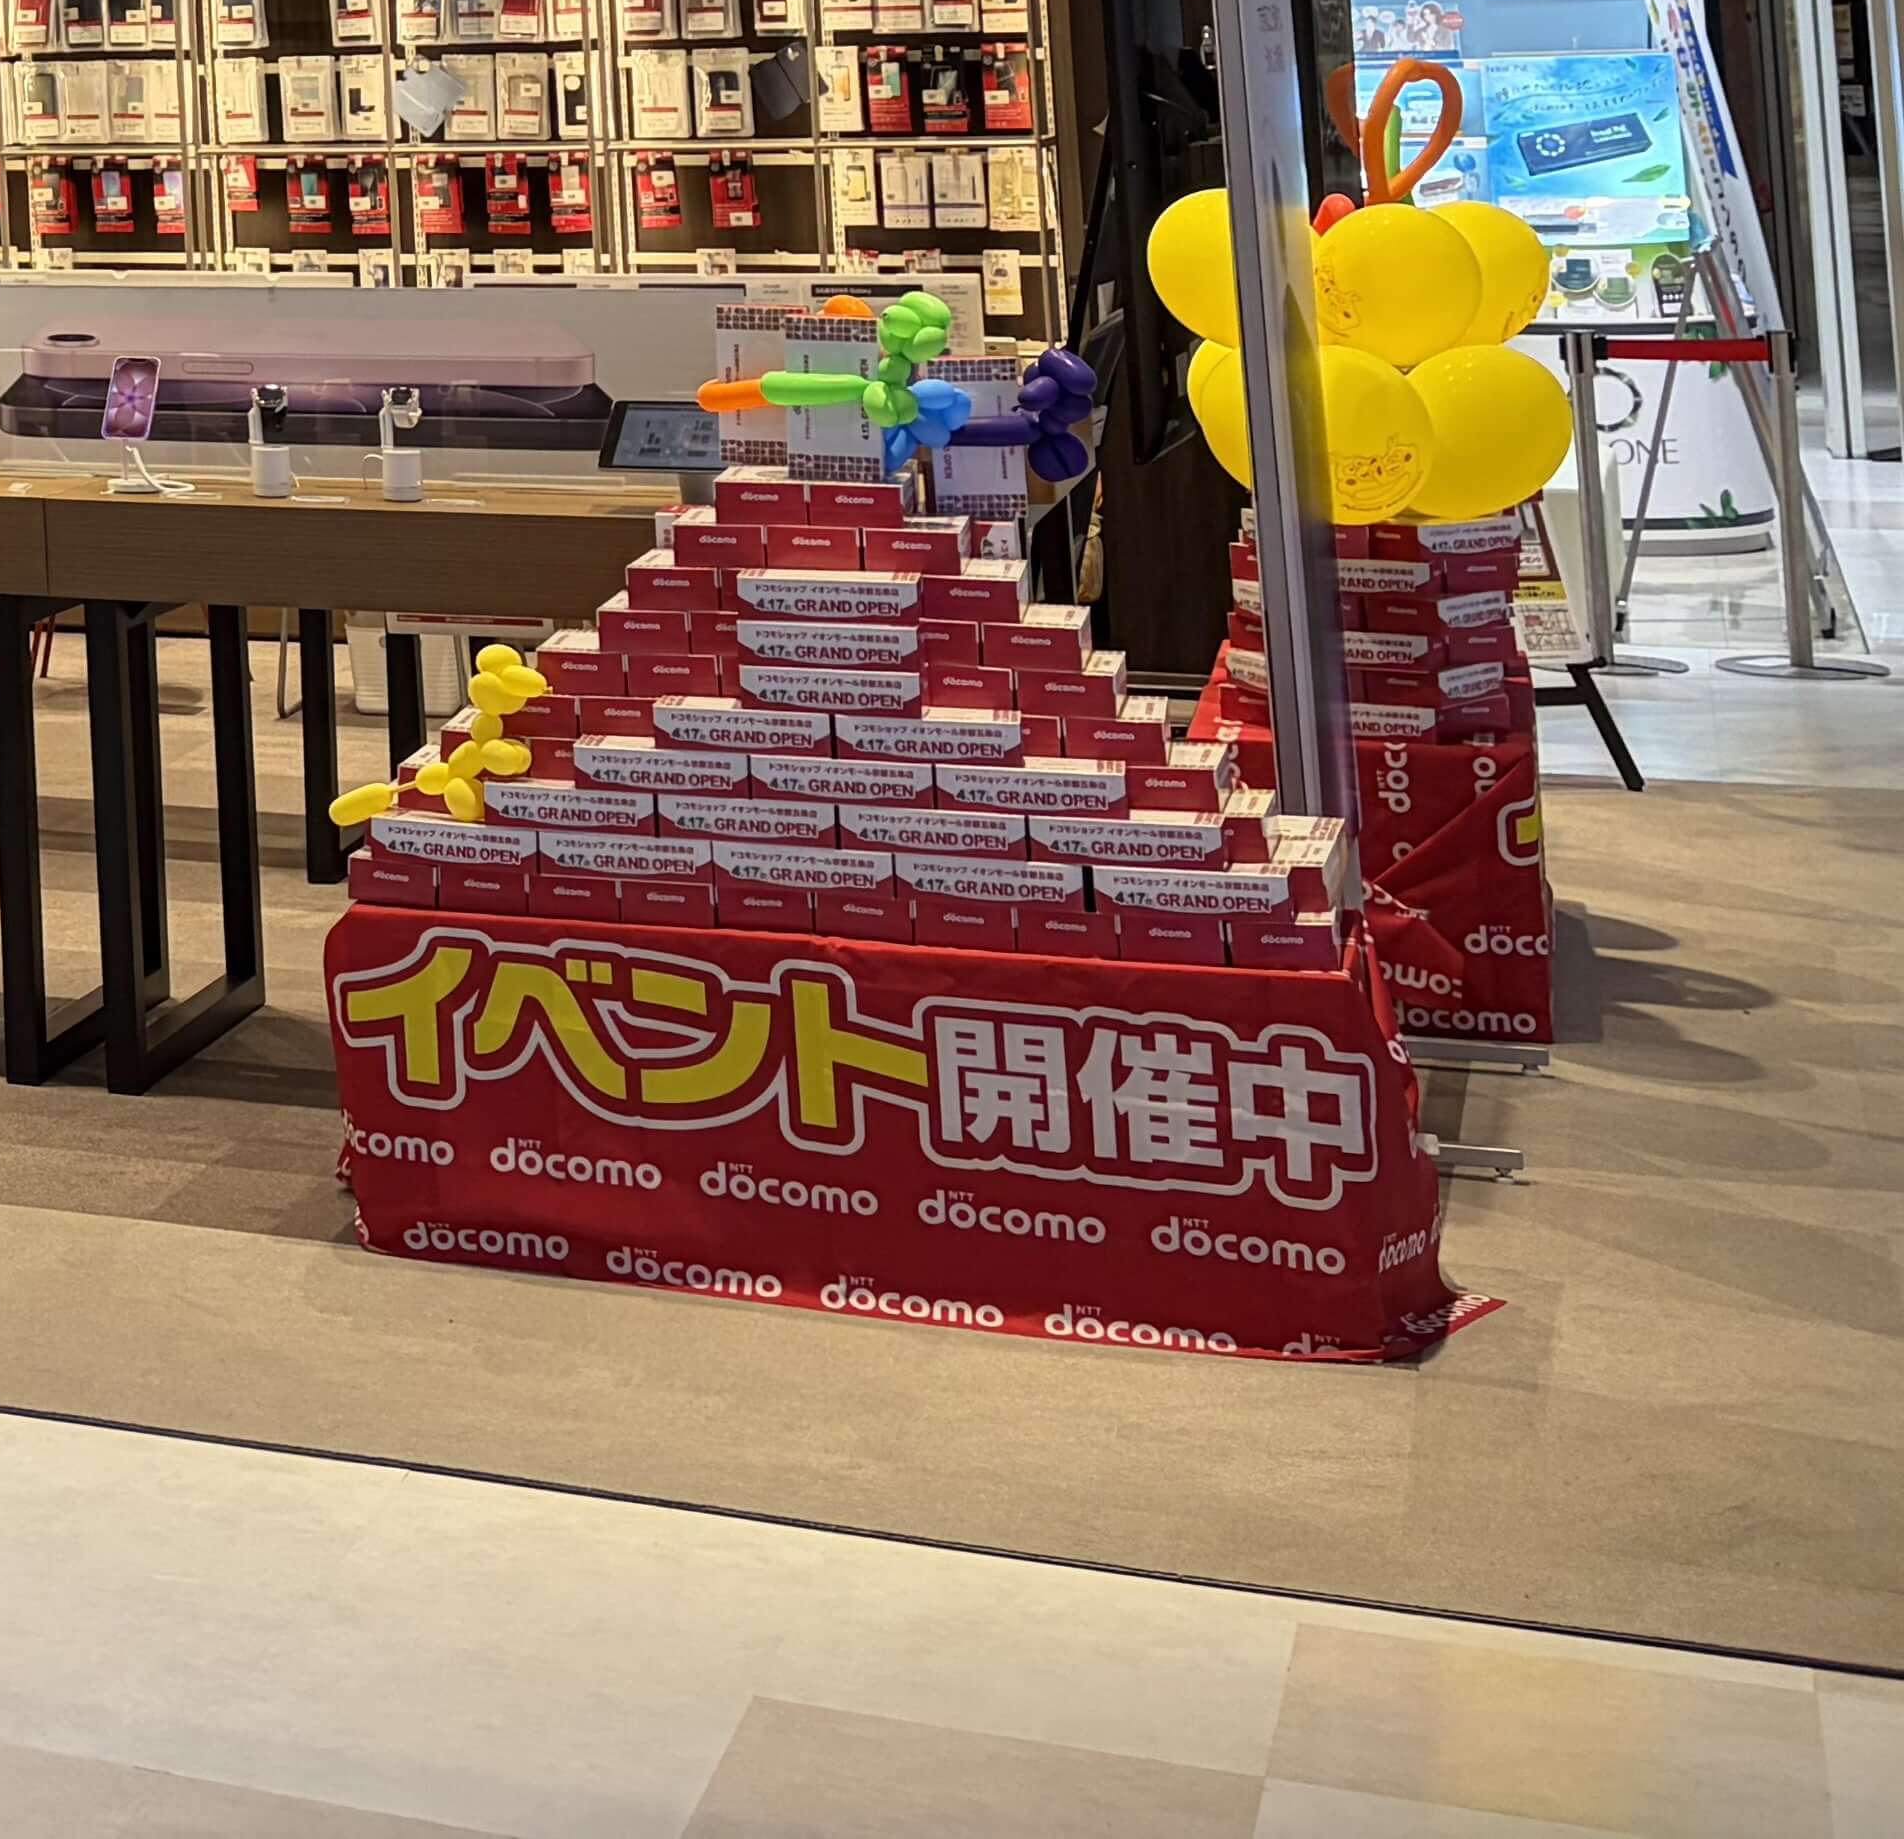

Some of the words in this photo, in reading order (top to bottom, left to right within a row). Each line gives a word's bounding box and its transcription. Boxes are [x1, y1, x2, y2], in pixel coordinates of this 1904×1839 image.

[794, 598, 852, 614] GRAND
[856, 601, 900, 615] OPEN
[795, 645, 853, 660] GRAND
[856, 648, 900, 662] OPEN
[797, 690, 855, 705] GRAND
[858, 693, 902, 707] OPEN
[709, 729, 768, 744] GRAND
[772, 732, 812, 747] OPEN
[894, 739, 954, 754] GRAND
[957, 742, 1003, 757] OPEN
[629, 770, 685, 786] GRAND
[689, 773, 732, 789] OPEN
[996, 790, 1058, 806] GRAND
[1060, 793, 1108, 809] OPEN
[899, 831, 958, 847] GRAND
[964, 834, 1007, 850] OPEN
[1091, 840, 1155, 856] GRAND
[1157, 843, 1204, 860] OPEN
[423, 843, 476, 860] GRAND
[479, 847, 520, 863] OPEN
[769, 867, 828, 884] GRAND
[831, 871, 875, 888] OPEN
[1156, 893, 1219, 909] GRAND
[1220, 896, 1271, 912] OPEN
[346, 945, 1370, 1182] イベント開催中
[490, 1136, 663, 1191] docomo
[700, 1160, 879, 1218] docomo
[918, 1189, 1106, 1244] docomo
[403, 1221, 569, 1262] docomo
[1151, 1216, 1346, 1276] docomo
[606, 1246, 783, 1300] docomo
[820, 1275, 1005, 1328] docomo
[1044, 1304, 1237, 1354] docomo
